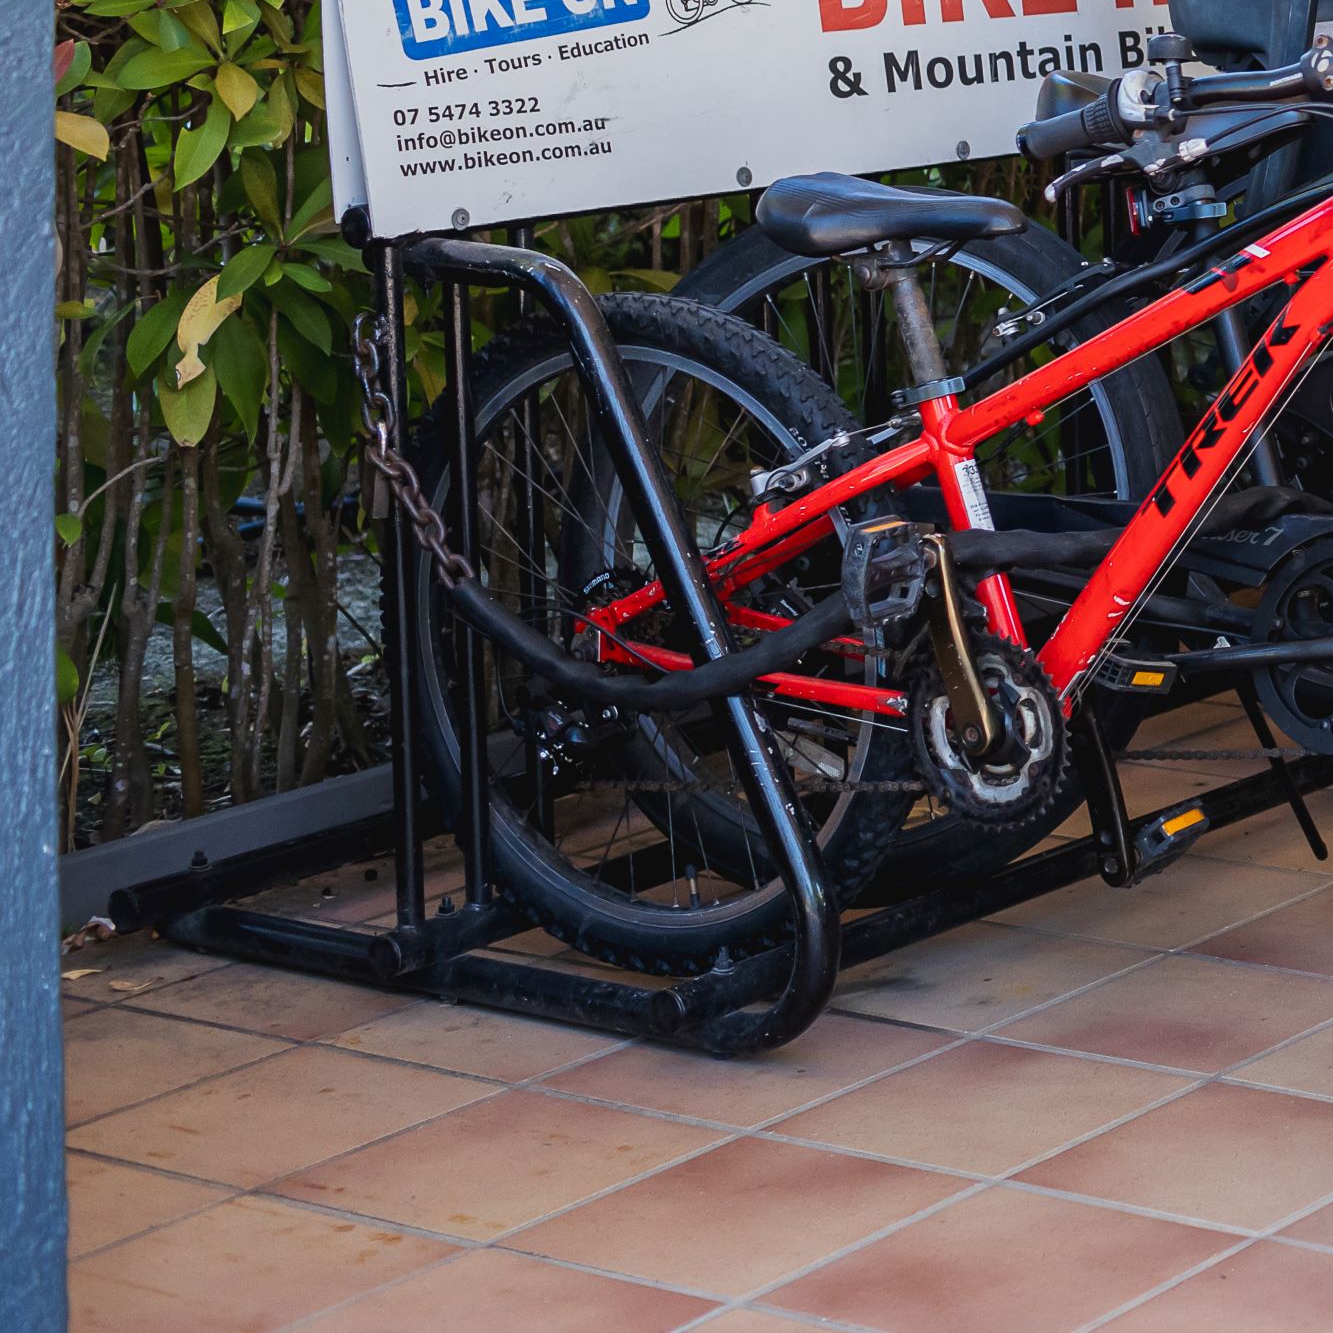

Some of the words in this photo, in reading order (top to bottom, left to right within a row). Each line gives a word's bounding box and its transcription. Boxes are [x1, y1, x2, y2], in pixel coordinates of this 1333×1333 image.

[424, 65, 469, 86] Hire
[484, 51, 542, 74] Tours
[558, 32, 650, 61] Education
[828, 55, 869, 98] &
[883, 34, 1104, 93] Mountain
[393, 108, 419, 126] 07
[428, 102, 482, 123] 5474
[488, 97, 541, 117] 3322
[397, 118, 607, 152] info@bikeon.com.au
[400, 141, 612, 177] www.bikeon.com.au
[1141, 298, 1300, 518] TREK
